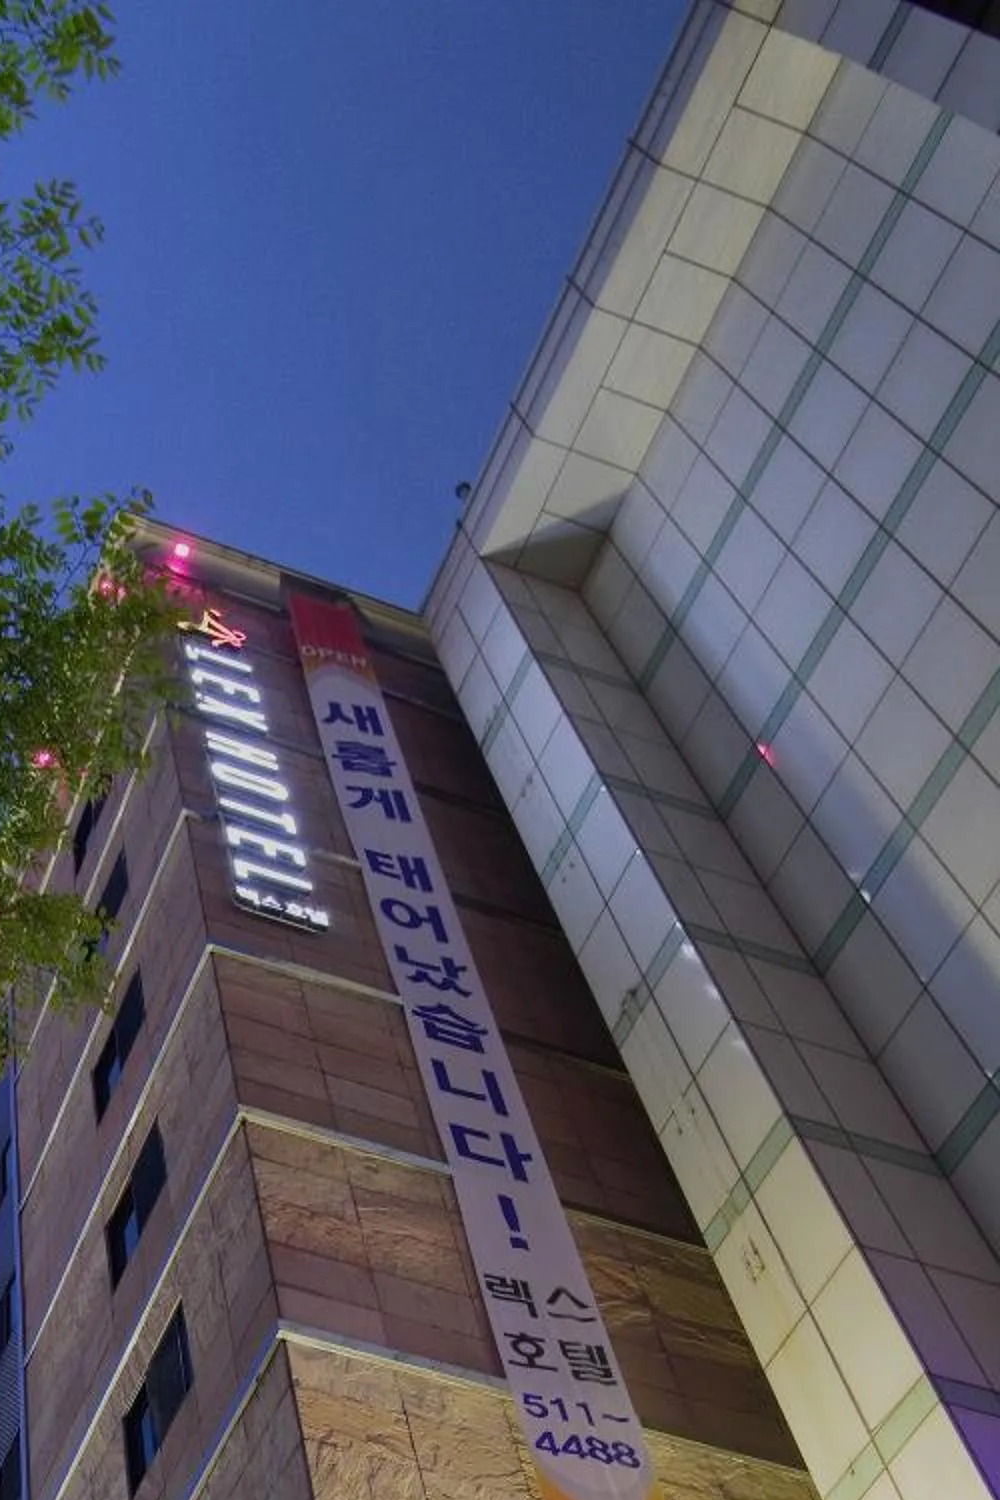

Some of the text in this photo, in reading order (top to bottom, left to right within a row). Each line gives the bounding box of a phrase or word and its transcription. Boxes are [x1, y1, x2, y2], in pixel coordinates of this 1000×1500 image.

[302, 645, 367, 668] OPEN
[186, 645, 313, 891] LEX HOTEL
[320, 701, 533, 1250] 새롭게 태어났습니다!
[483, 1273, 597, 1323] 렉스
[504, 1331, 618, 1386] 호텔
[534, 1430, 642, 1469] 4488
